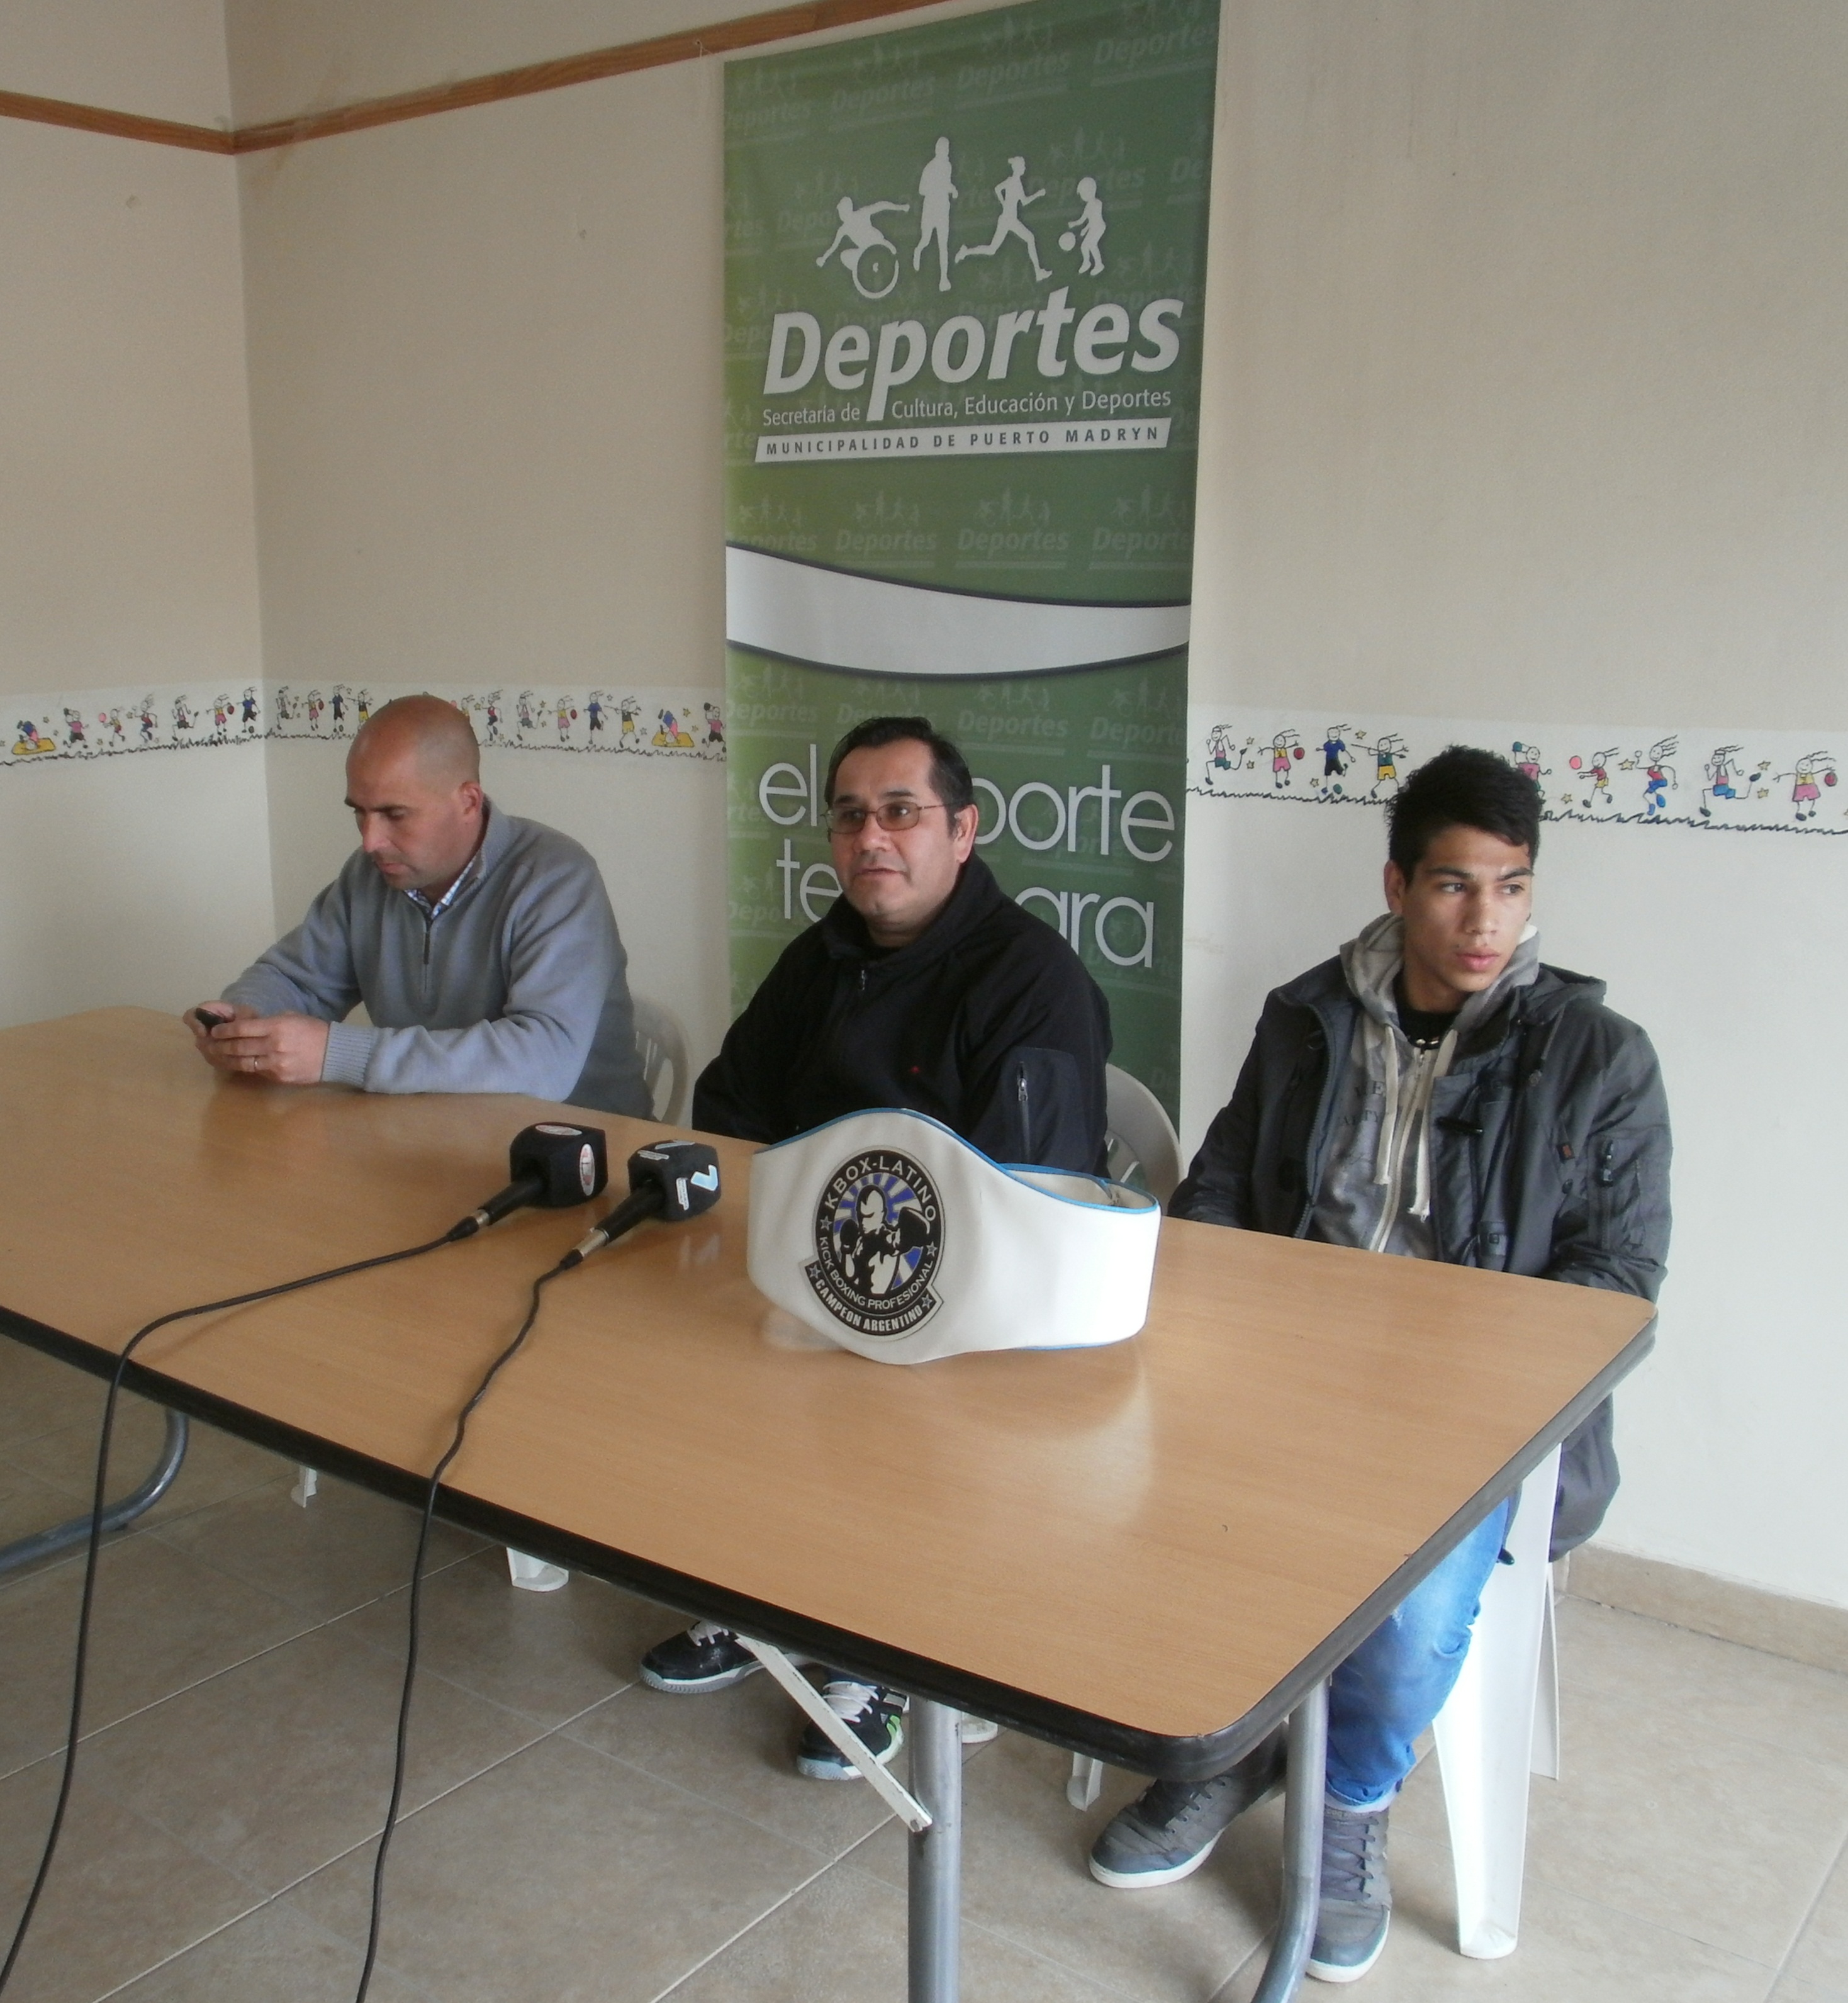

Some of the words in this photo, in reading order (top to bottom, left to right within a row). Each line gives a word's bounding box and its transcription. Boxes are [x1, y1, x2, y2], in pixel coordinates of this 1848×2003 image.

[763, 286, 1184, 422] Deportes
[763, 405, 835, 426] Secretaría
[841, 403, 860, 421] de
[892, 398, 958, 419] Cultura,
[965, 392, 1058, 415] Educación
[1065, 395, 1075, 415] y
[1082, 389, 1172, 413] Deportes
[766, 436, 919, 455] MUNICIPALIDAD
[933, 434, 955, 447] DE
[970, 430, 1050, 446] PUERTO
[1065, 427, 1158, 442] MADRYN
[834, 529, 938, 558] Deportes
[957, 527, 1070, 559] Deportes
[1092, 527, 1191, 559] Deporte
[957, 709, 1069, 741] Deportes
[1090, 716, 1185, 749] Deporte
[759, 743, 818, 828] el
[971, 763, 1175, 863] porte
[824, 1155, 936, 1221] KBOX-LATINO
[819, 1236, 834, 1270] KICK
[830, 1269, 866, 1306] BOXING
[867, 1260, 934, 1310] PROFESIONAL
[815, 1279, 862, 1327] CAMPEON
[863, 1304, 923, 1332] ARGENTINO
